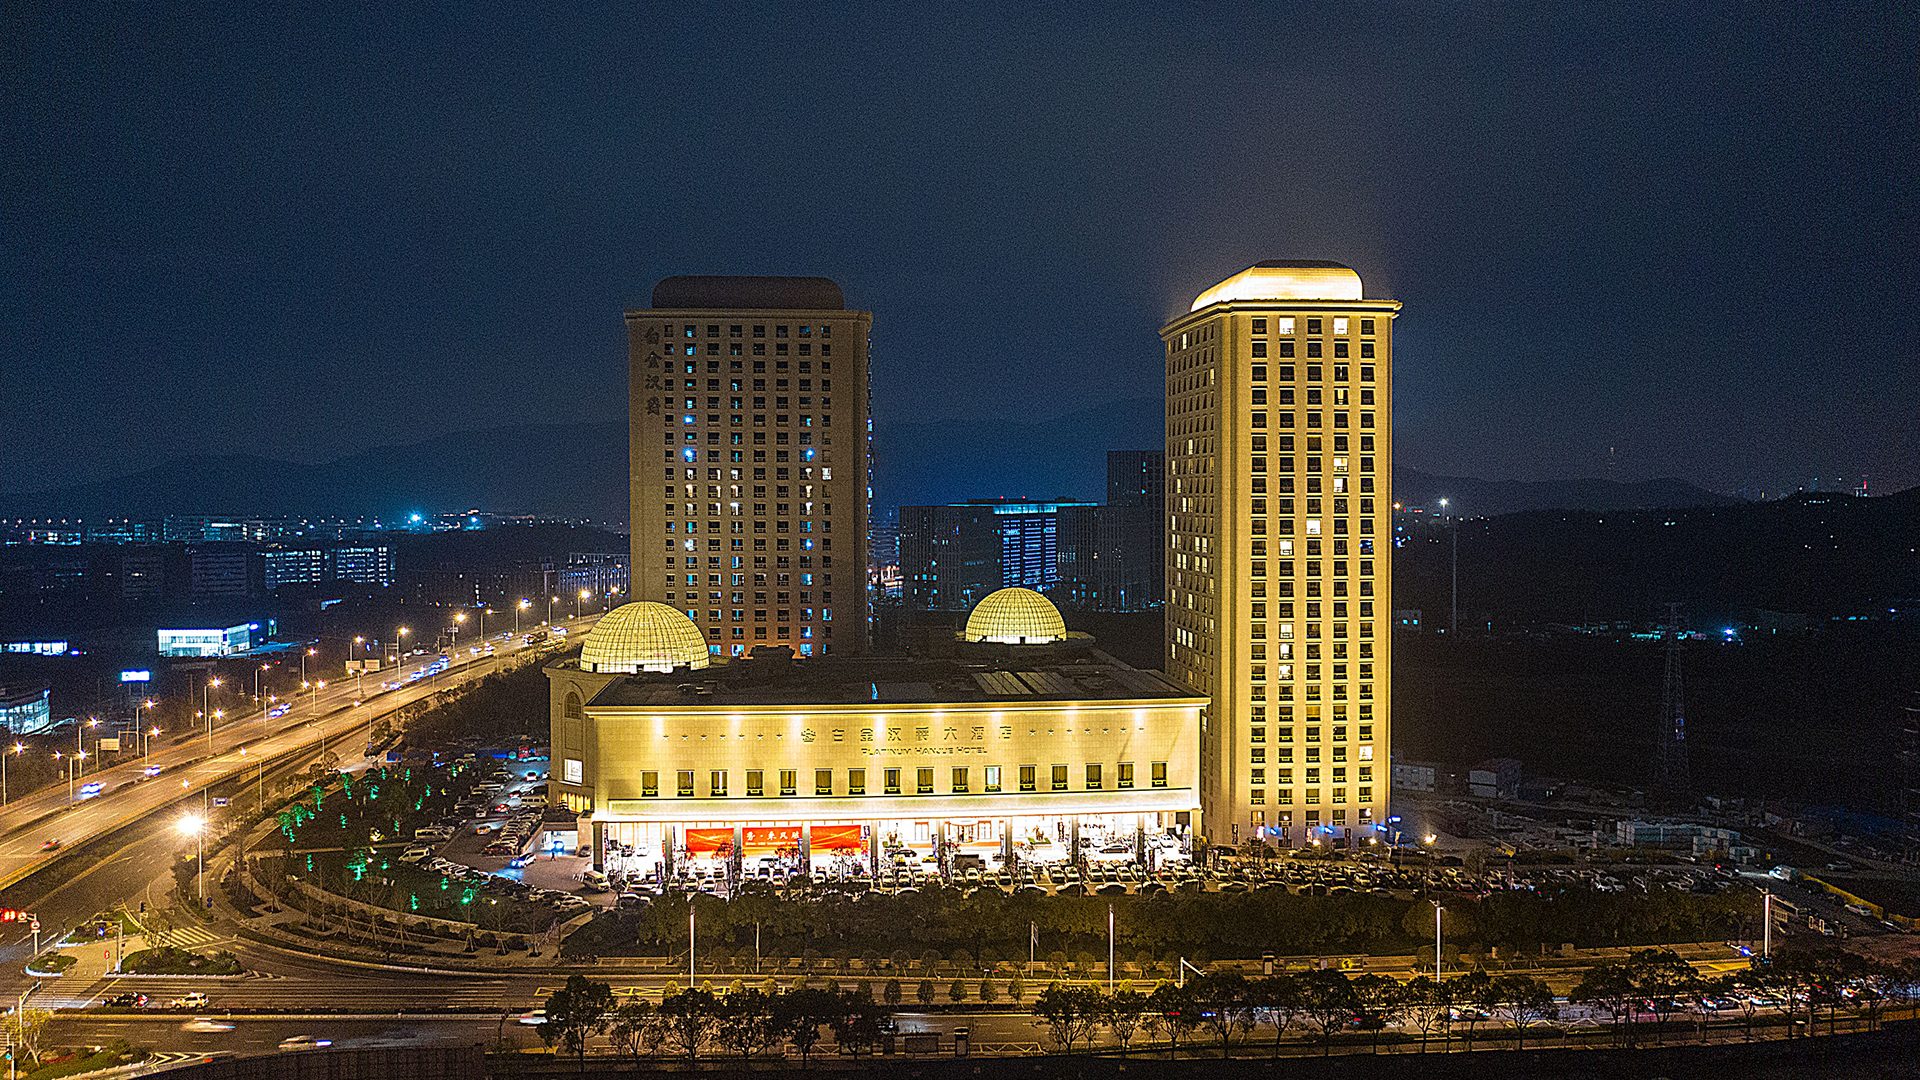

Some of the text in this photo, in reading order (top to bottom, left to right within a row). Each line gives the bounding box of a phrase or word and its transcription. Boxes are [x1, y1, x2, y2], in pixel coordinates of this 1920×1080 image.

[861, 746, 988, 756] PLATINUM HANJUE HOTEL
